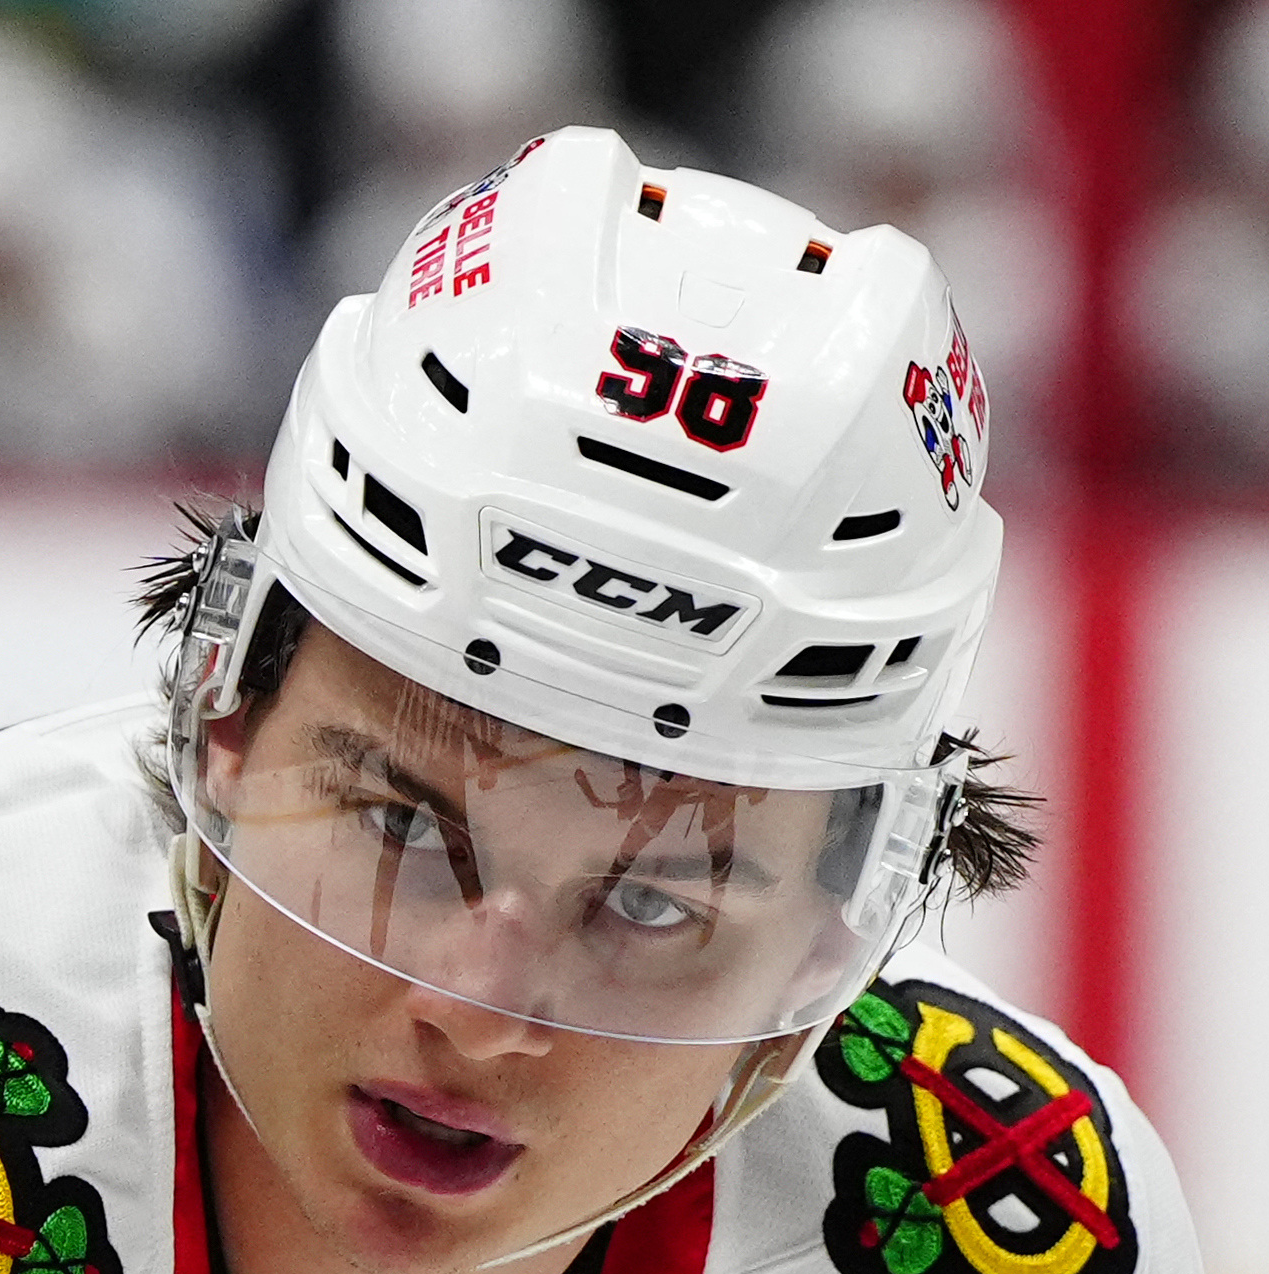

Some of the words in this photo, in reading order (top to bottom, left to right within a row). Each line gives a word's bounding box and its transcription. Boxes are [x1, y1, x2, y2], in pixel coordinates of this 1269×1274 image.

[408, 225, 451, 310] TIRE
[454, 191, 499, 297] BELLE
[596, 325, 769, 453] 98
[495, 528, 740, 636] CCM
